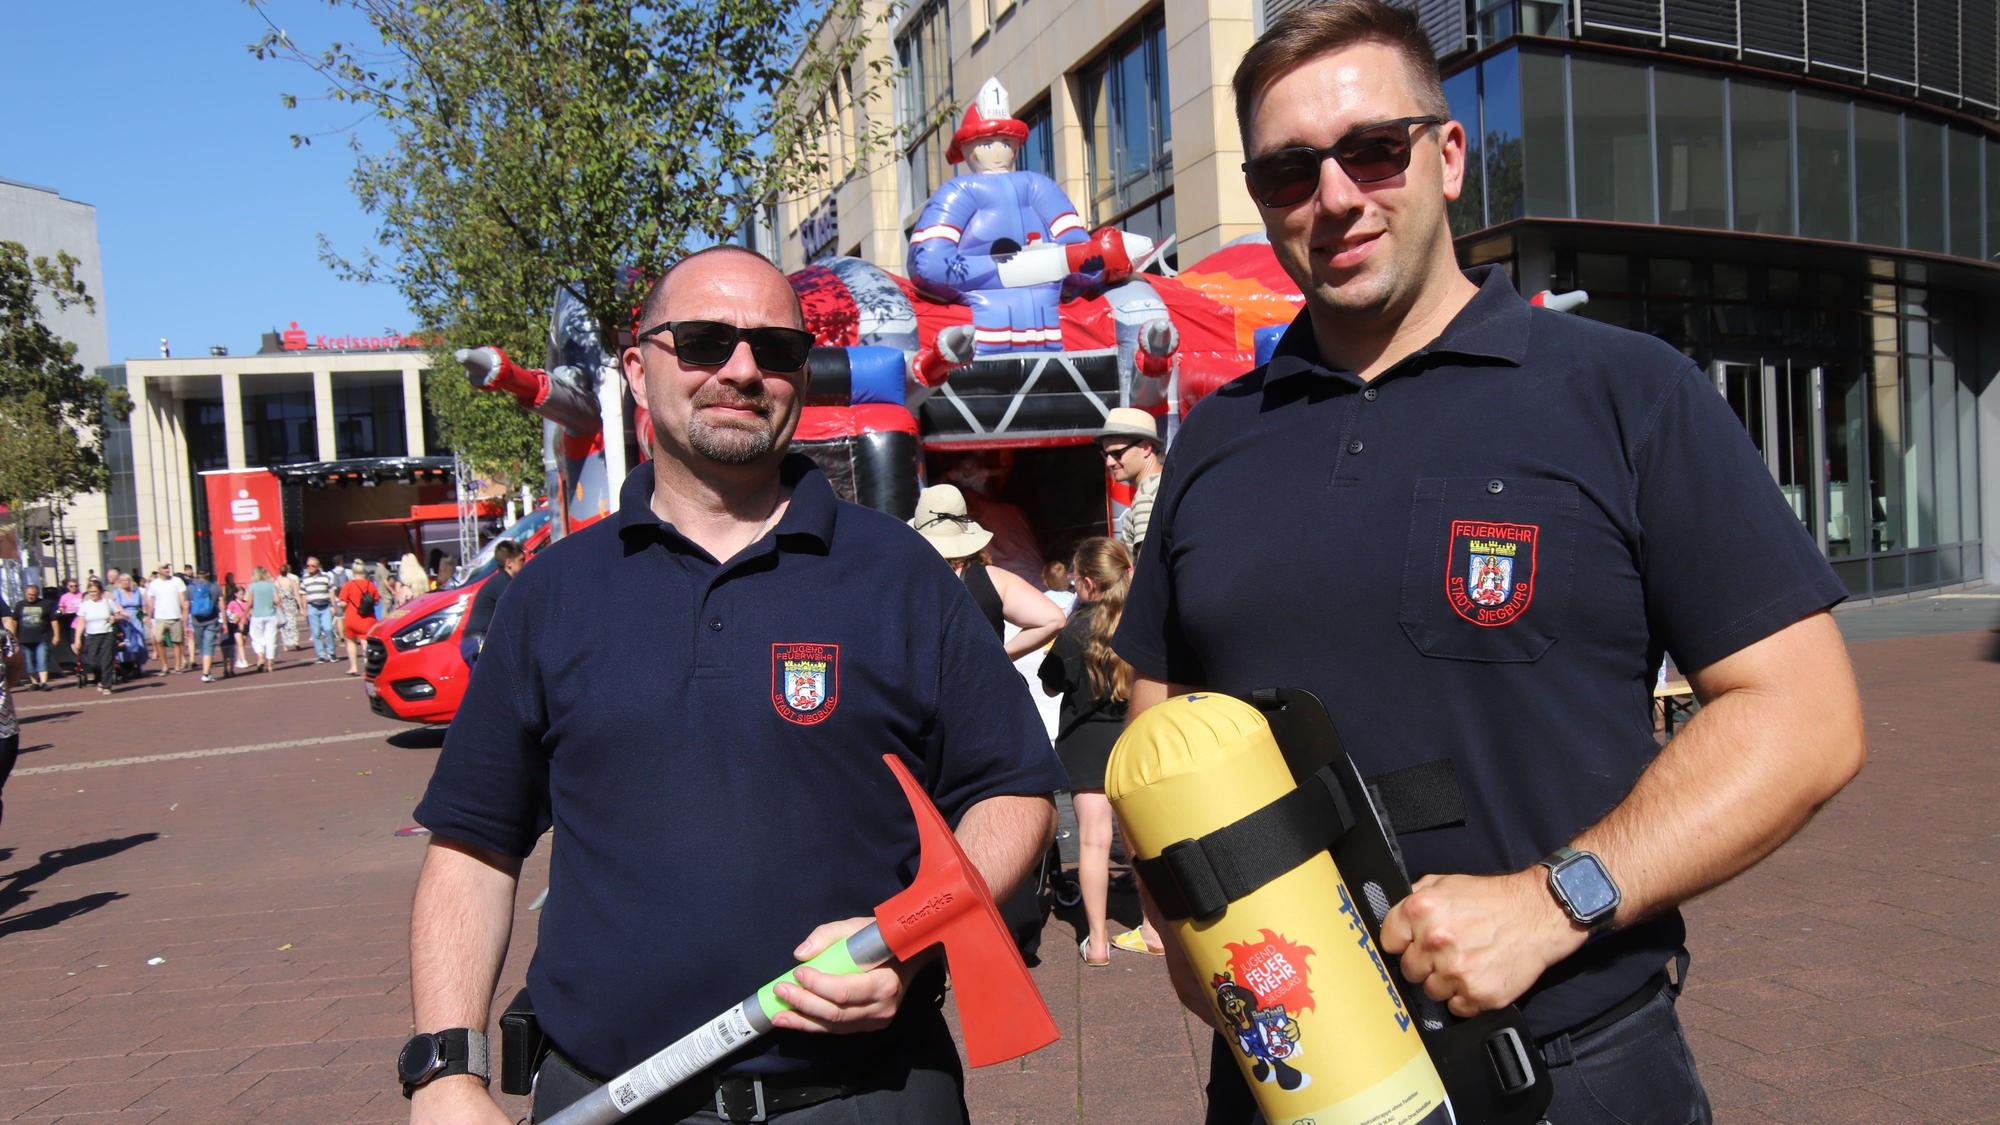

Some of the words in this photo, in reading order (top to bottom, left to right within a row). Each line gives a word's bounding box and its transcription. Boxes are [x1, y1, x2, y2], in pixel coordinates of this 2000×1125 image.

[991, 87, 1000, 105] 1
[1456, 525, 1531, 542] FEUERWEHR
[1451, 576, 1475, 612] STADT
[1477, 582, 1528, 622] SIEGBURG
[776, 653, 833, 662] FEUERWEHR
[786, 645, 824, 654] JUGEND
[775, 693, 797, 719] STADT
[796, 696, 835, 722] SIEGBURG
[1240, 944, 1277, 974] JUGEND
[1244, 952, 1288, 986] FEUER
[1253, 963, 1297, 997] WEHR
